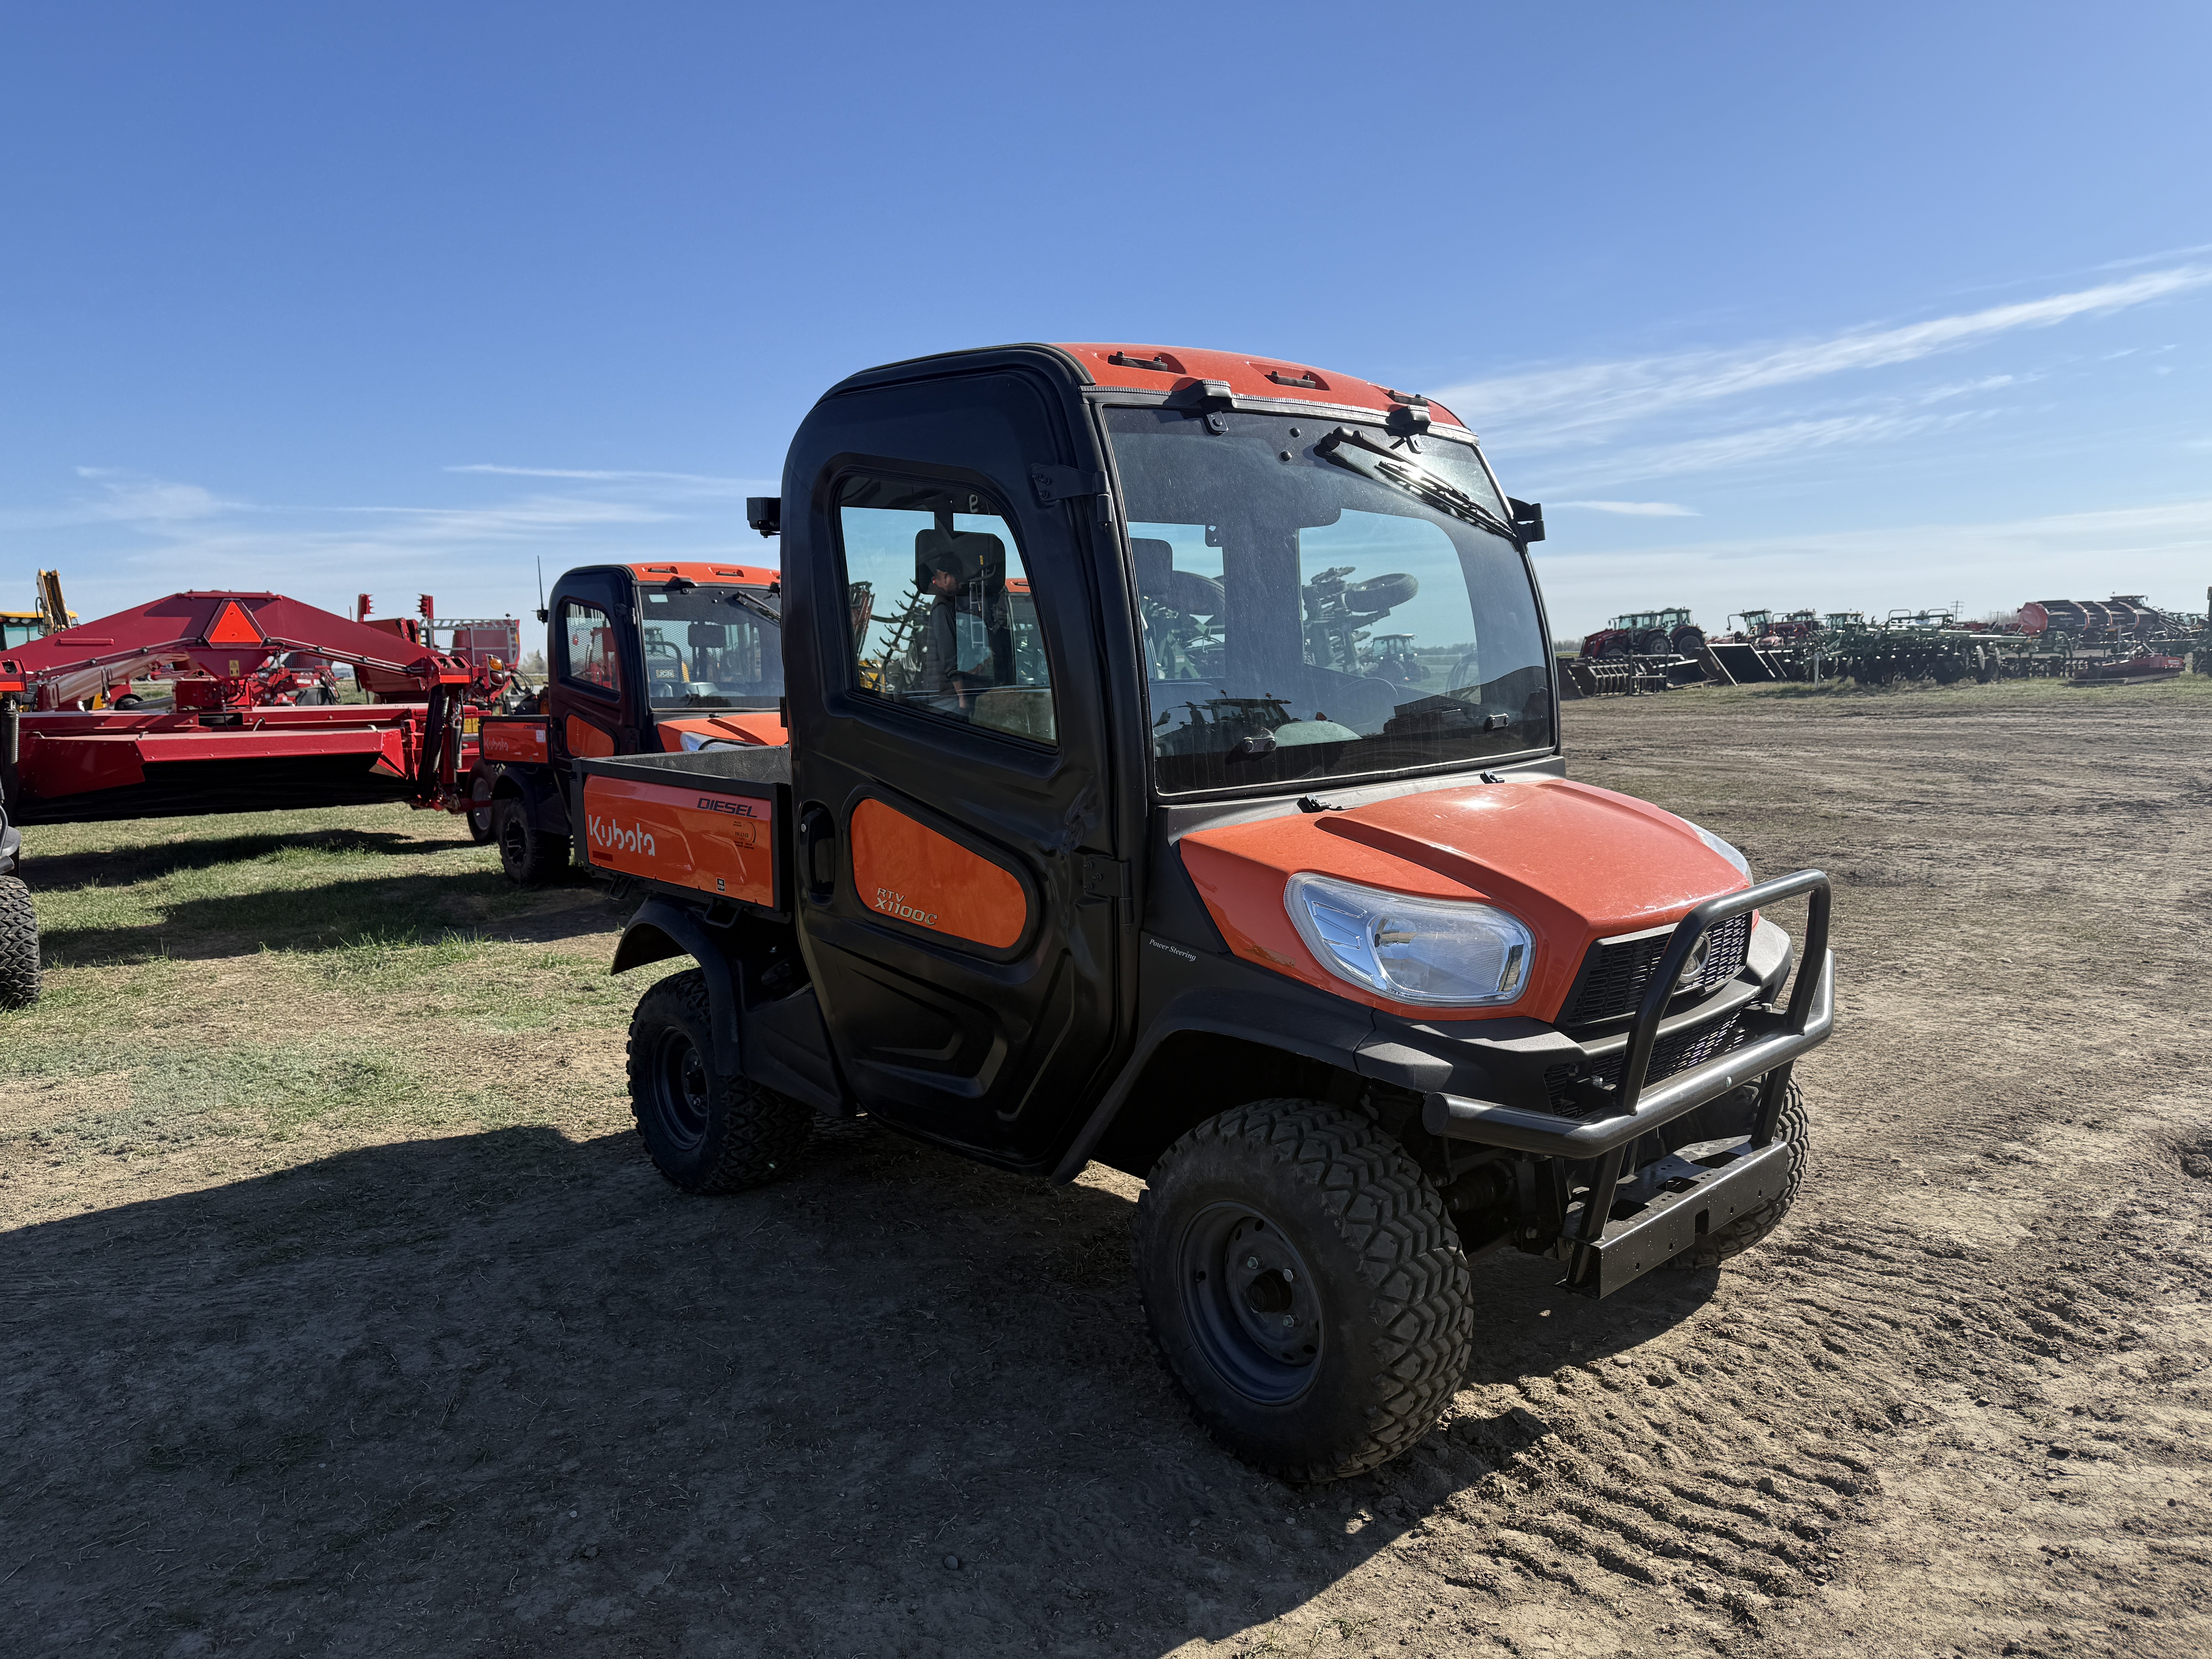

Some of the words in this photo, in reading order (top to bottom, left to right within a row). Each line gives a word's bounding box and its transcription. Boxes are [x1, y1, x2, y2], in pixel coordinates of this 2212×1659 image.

[697, 798, 757, 818] DIESEL
[589, 815, 655, 856] Kubota
[877, 887, 905, 902] RTV
[874, 897, 938, 925] X1100C
[1149, 939, 1169, 950] Power
[1169, 946, 1197, 962] Steering
